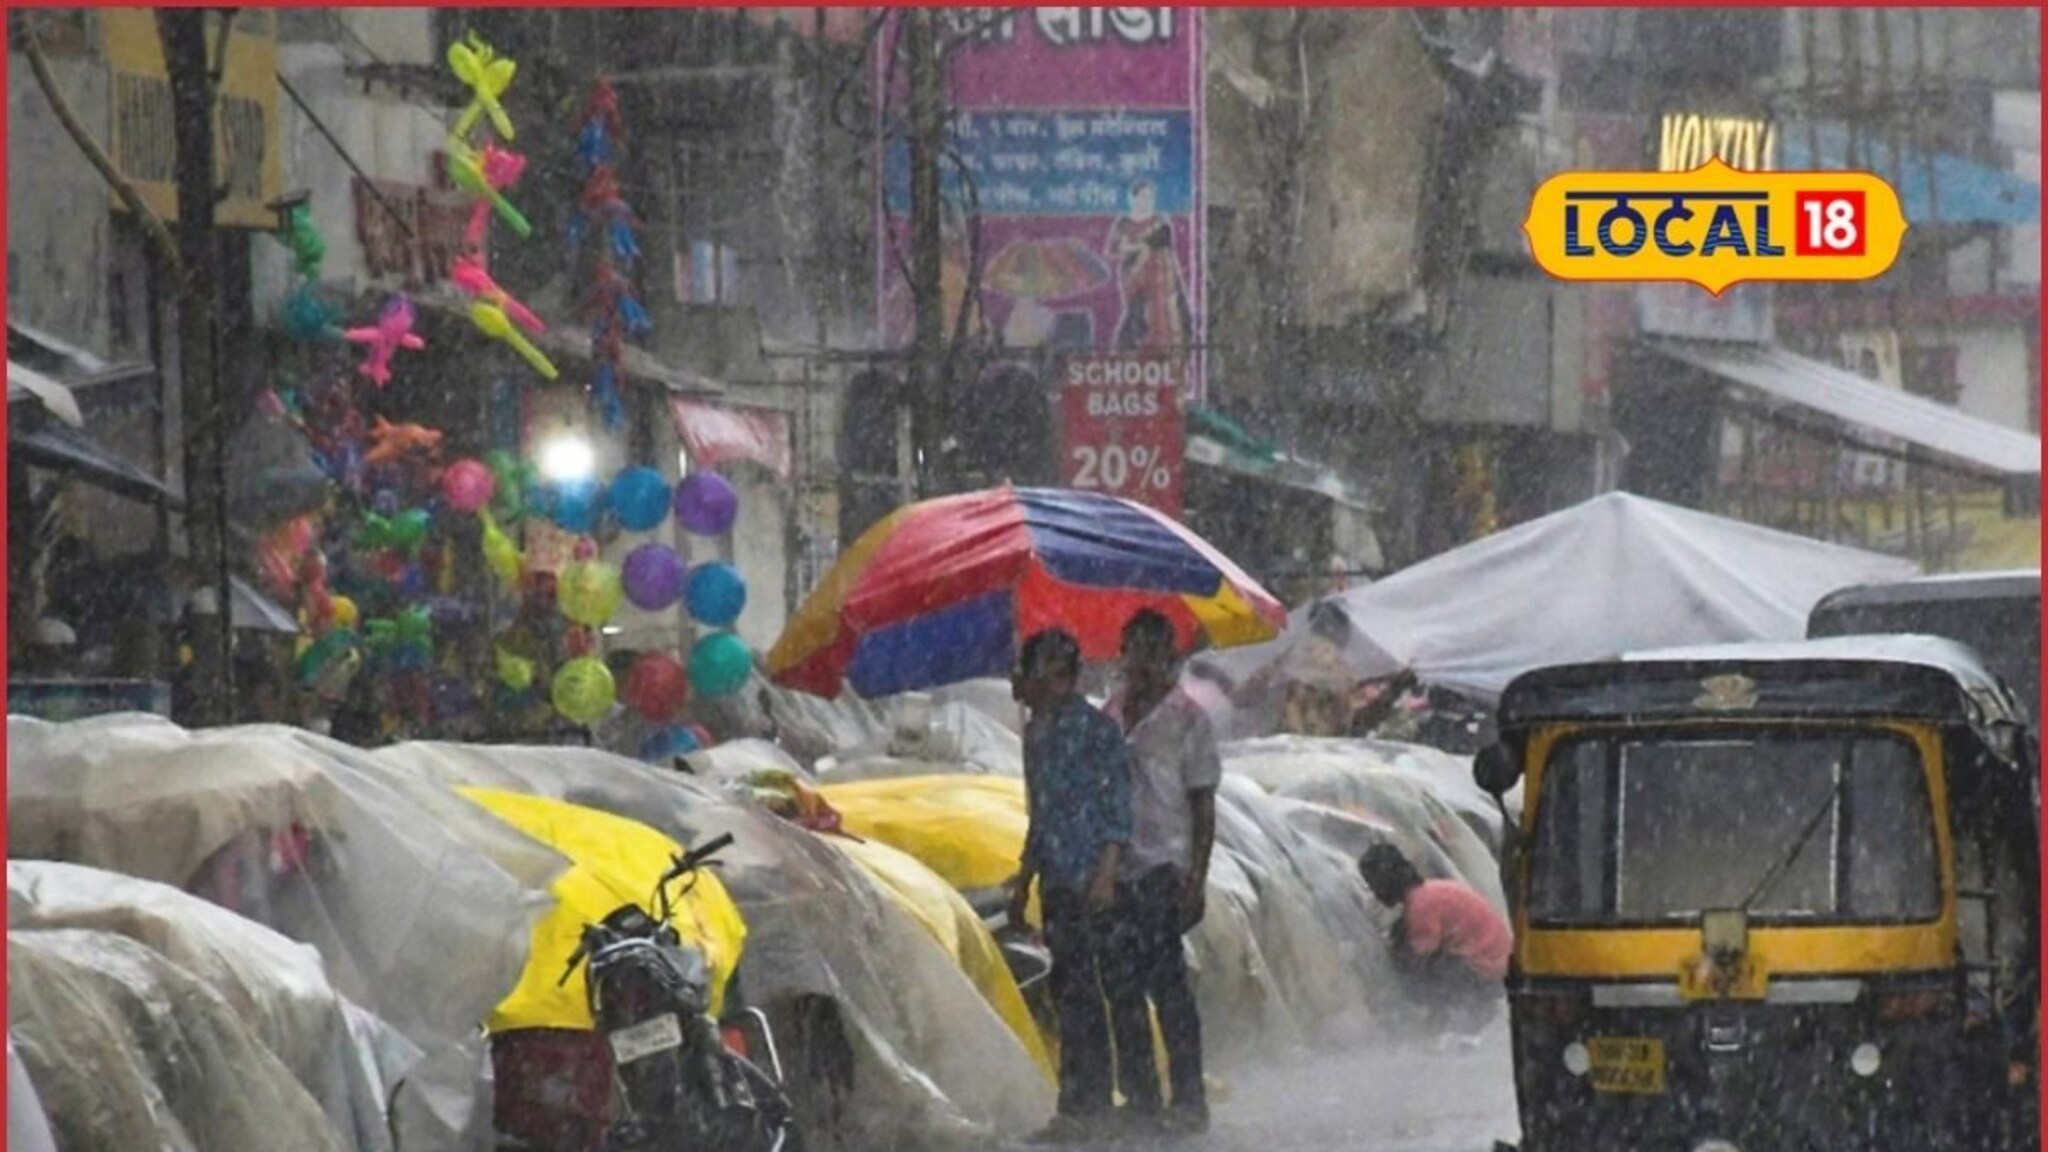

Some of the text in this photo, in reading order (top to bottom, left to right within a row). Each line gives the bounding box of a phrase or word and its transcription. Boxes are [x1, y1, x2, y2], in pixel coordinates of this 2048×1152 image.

[1068, 360, 1175, 385] SCHOOL
[1088, 392, 1159, 416] BAGS
[1071, 443, 1170, 489] 20%
